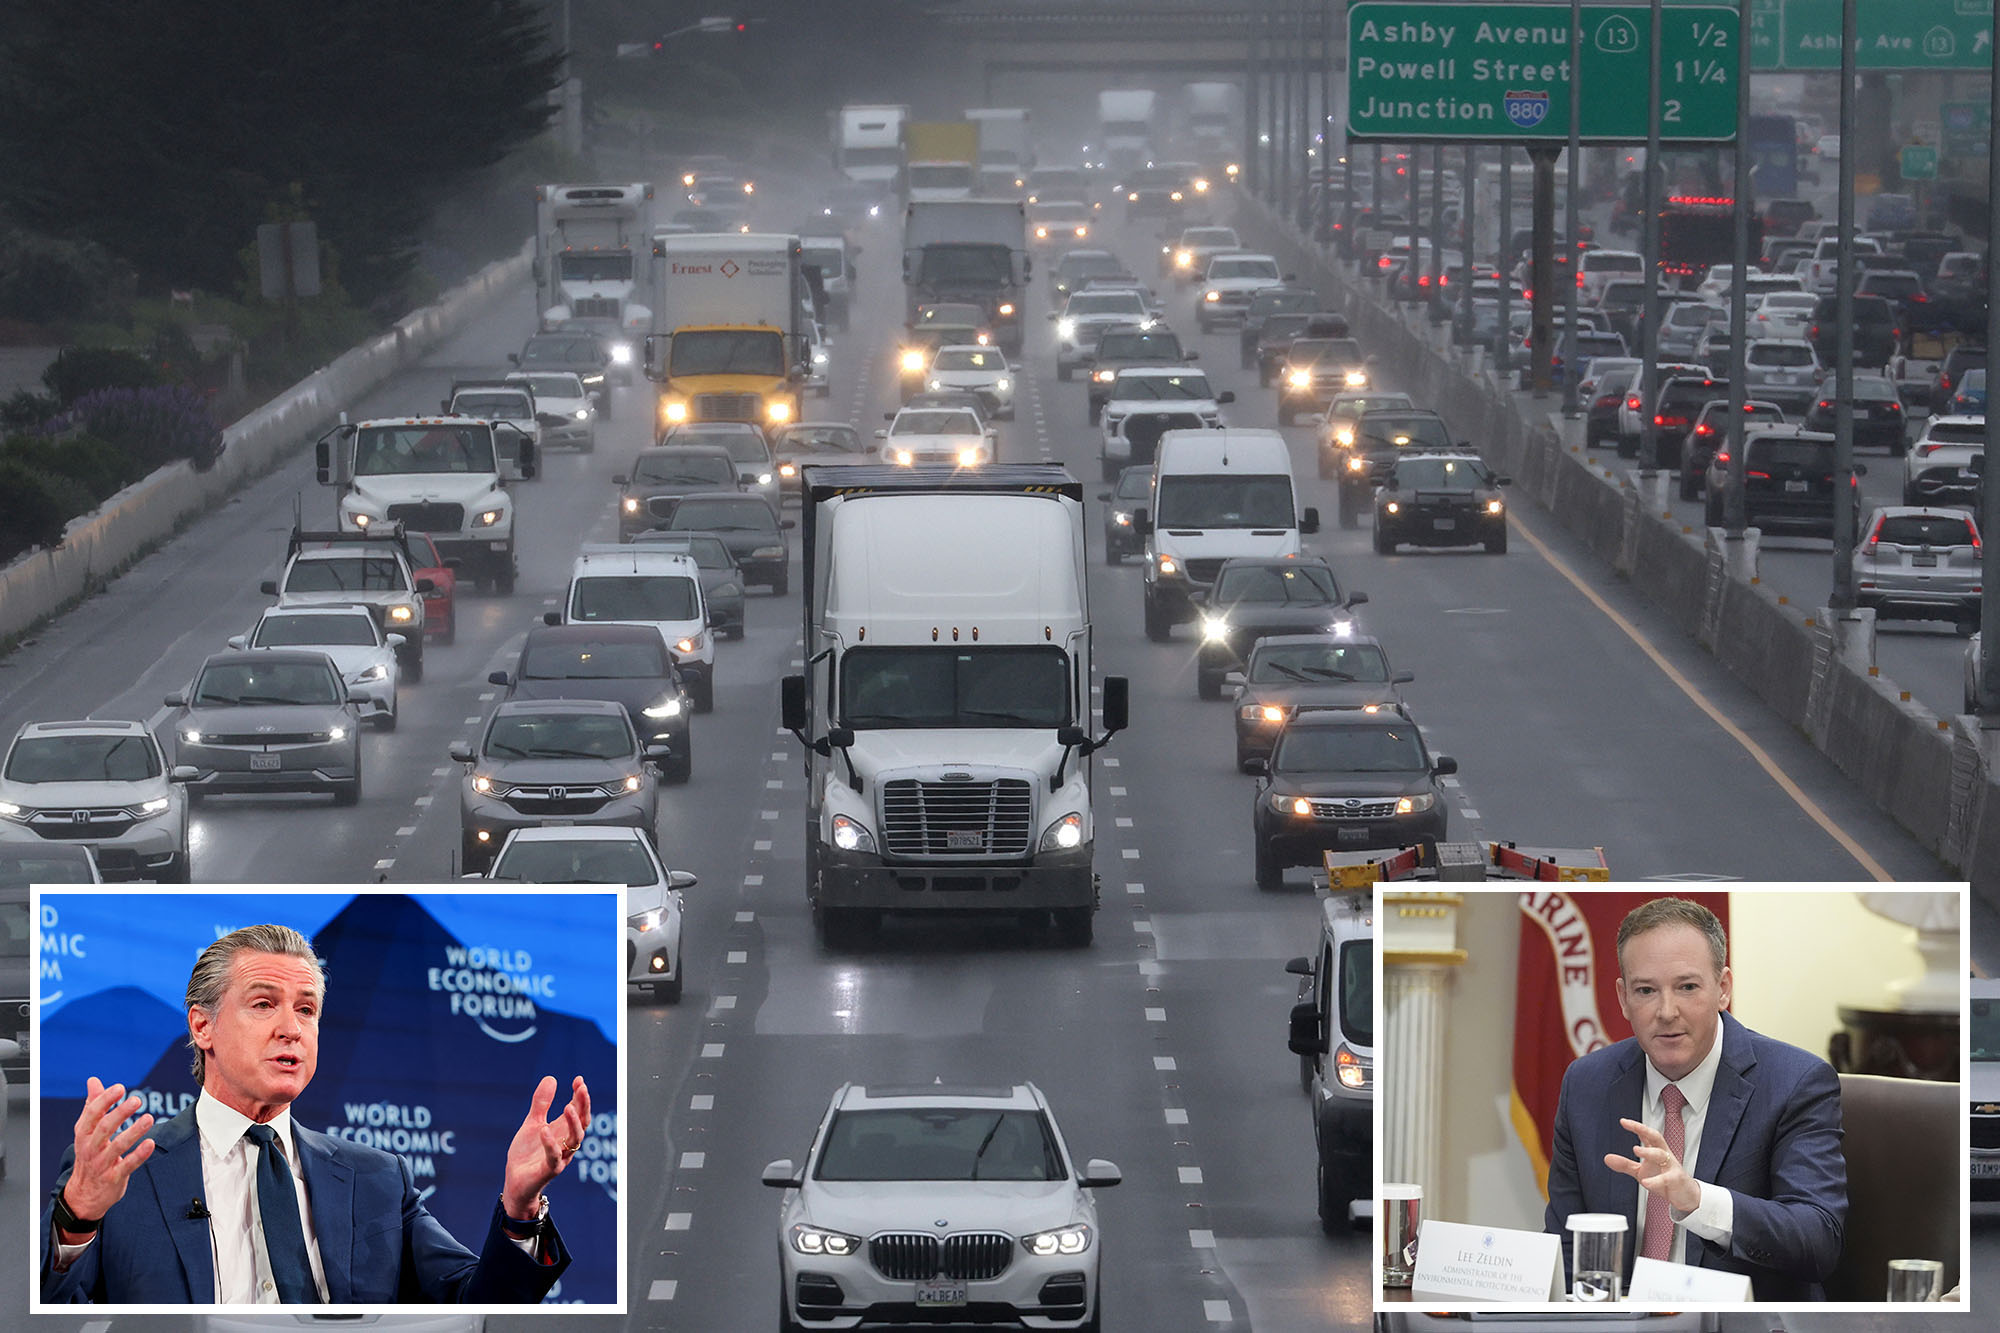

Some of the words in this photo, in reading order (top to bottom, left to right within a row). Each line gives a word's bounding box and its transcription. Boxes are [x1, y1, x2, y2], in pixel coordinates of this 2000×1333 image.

[1359, 20, 1456, 48] Ashby
[1608, 28, 1628, 44] 13
[1800, 34, 1862, 53] Ashy
[1875, 34, 1912, 49] Ave
[1358, 57, 1455, 80] Powell
[1473, 59, 1570, 81] Street
[1359, 97, 1493, 119] Junction
[1509, 102, 1544, 119] 880
[1664, 100, 1681, 121] 2
[672, 263, 712, 274] Ernest
[445, 945, 532, 972] WORLD
[428, 967, 556, 998] ECONOMIC
[450, 992, 536, 1019] FORUM
[116, 1089, 196, 1116] ORLD
[344, 1102, 431, 1128] WORLD
[1458, 1250, 1474, 1263] LEE
[1476, 1252, 1514, 1267] ZELDIN
[1417, 1272, 1473, 1287] ENVIRONMENTAL
[1475, 1280, 1518, 1293] PROTECTION
[1519, 1286, 1546, 1296] AGENCY
[1442, 1265, 1497, 1279] ADMINISTRATOR
